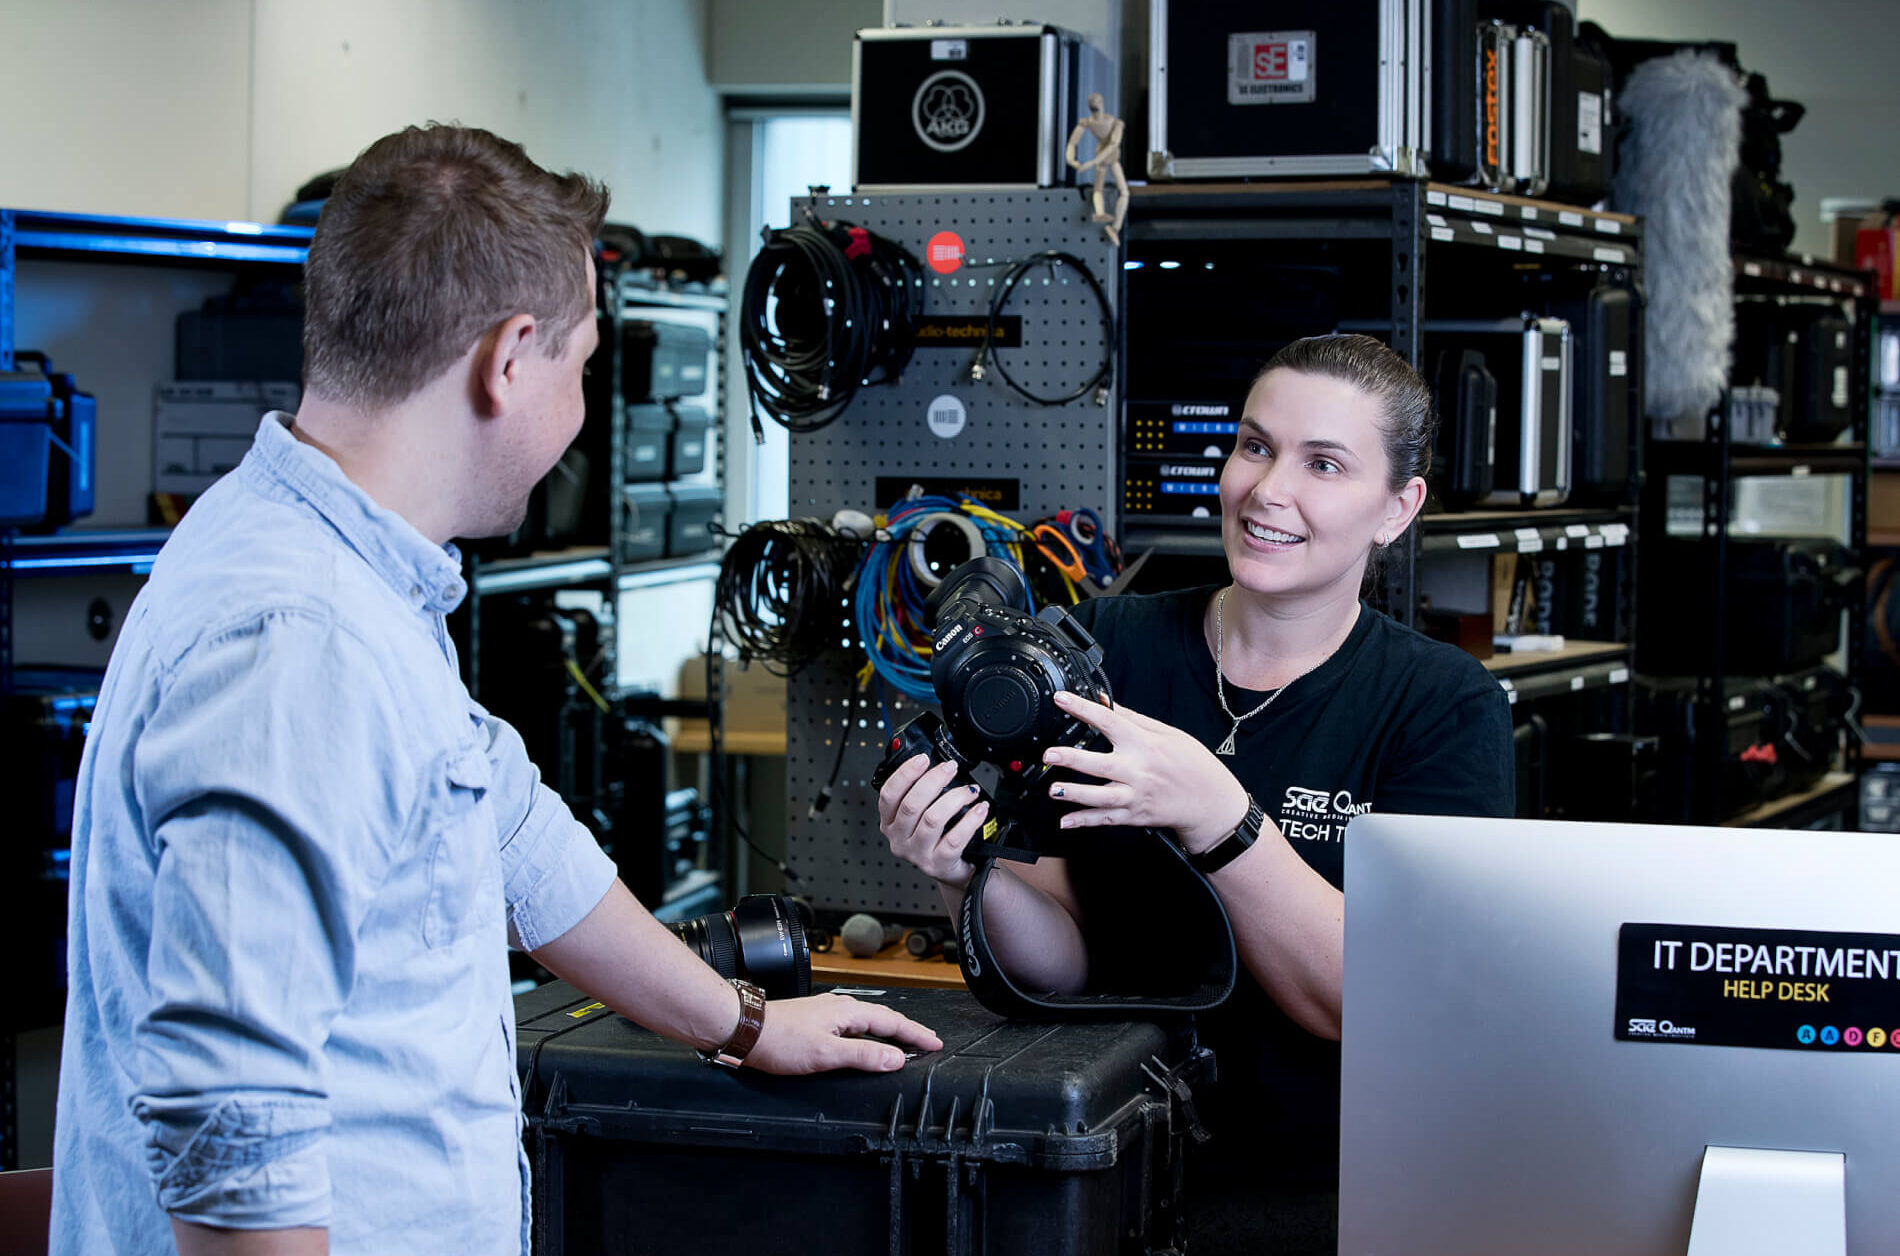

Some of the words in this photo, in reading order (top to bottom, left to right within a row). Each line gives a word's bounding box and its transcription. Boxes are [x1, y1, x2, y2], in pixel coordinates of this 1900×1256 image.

[935, 623, 964, 651] Canon
[962, 632, 974, 644] EOS
[1281, 808, 1319, 820] CREATIVE
[1279, 818, 1331, 842] TECH
[1654, 940, 1683, 970] IT
[1723, 979, 1774, 999] HELP
[1778, 981, 1830, 1003] DESK
